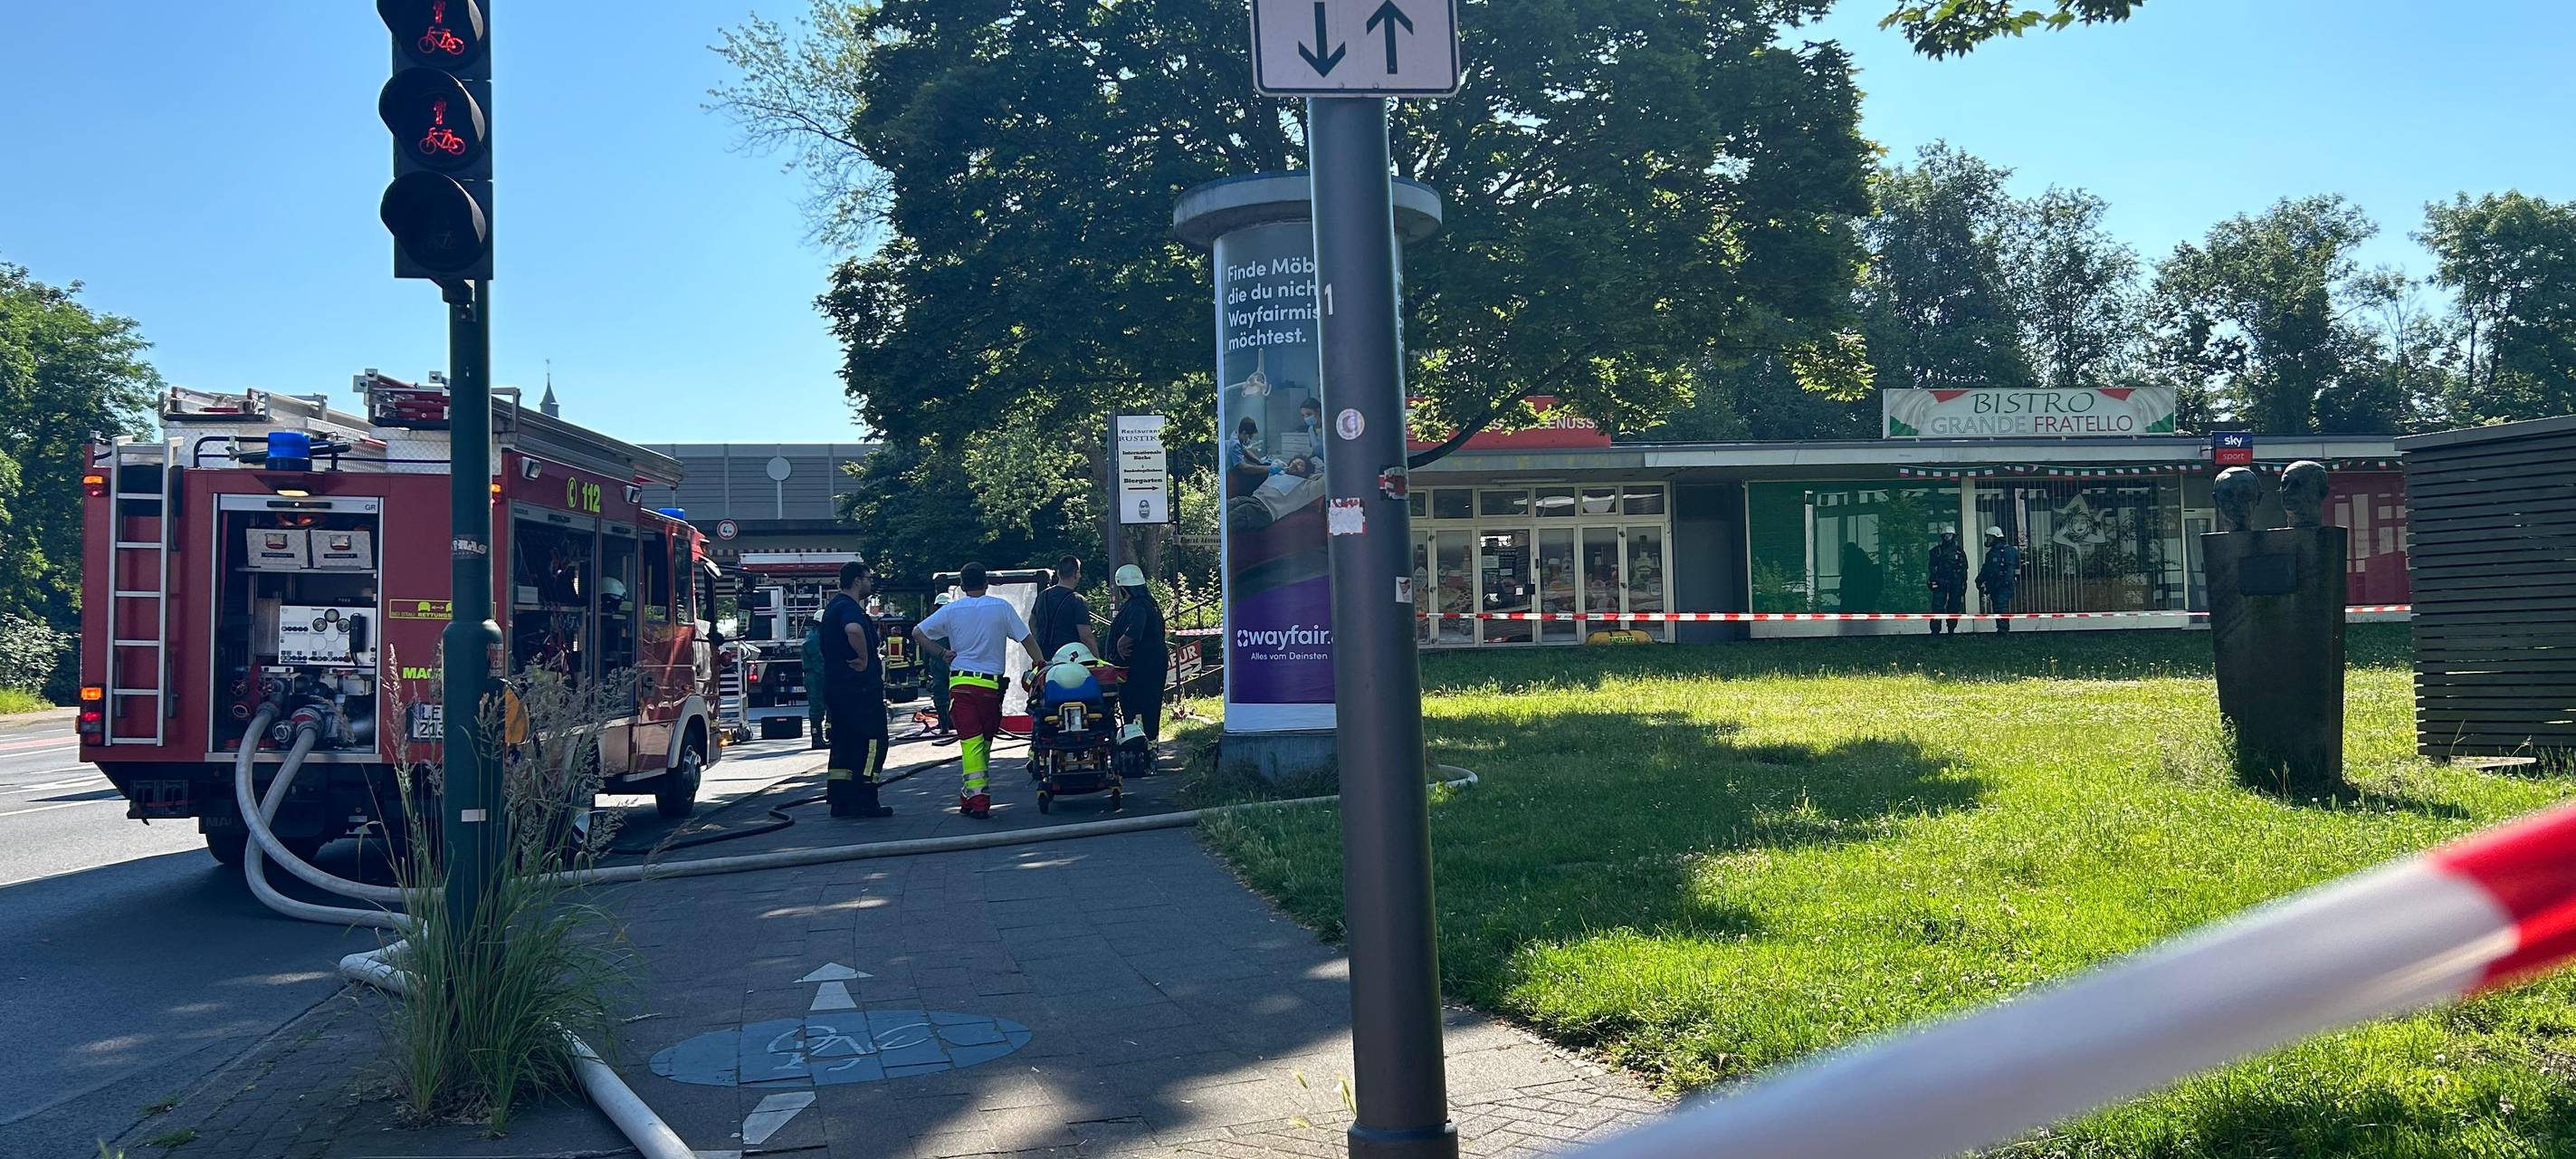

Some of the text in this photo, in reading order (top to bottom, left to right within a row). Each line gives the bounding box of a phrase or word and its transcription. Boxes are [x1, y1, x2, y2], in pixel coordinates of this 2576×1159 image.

[1227, 257, 1315, 283] Finde Möb
[1227, 280, 1317, 305] die du nich
[1227, 303, 1320, 329] Wayfairmis
[1228, 328, 1307, 350] möchtest.
[1970, 391, 2095, 414] BISTRO
[1932, 415, 2133, 435] GRANDE FRATELLO
[2224, 435, 2243, 447] sky
[2222, 453, 2246, 461] sport
[581, 482, 601, 513] 112
[1249, 625, 1334, 651] wayfair.
[1168, 645, 1198, 667] EUR
[1251, 652, 1268, 660] Alles
[1289, 651, 1328, 660] Deinsten
